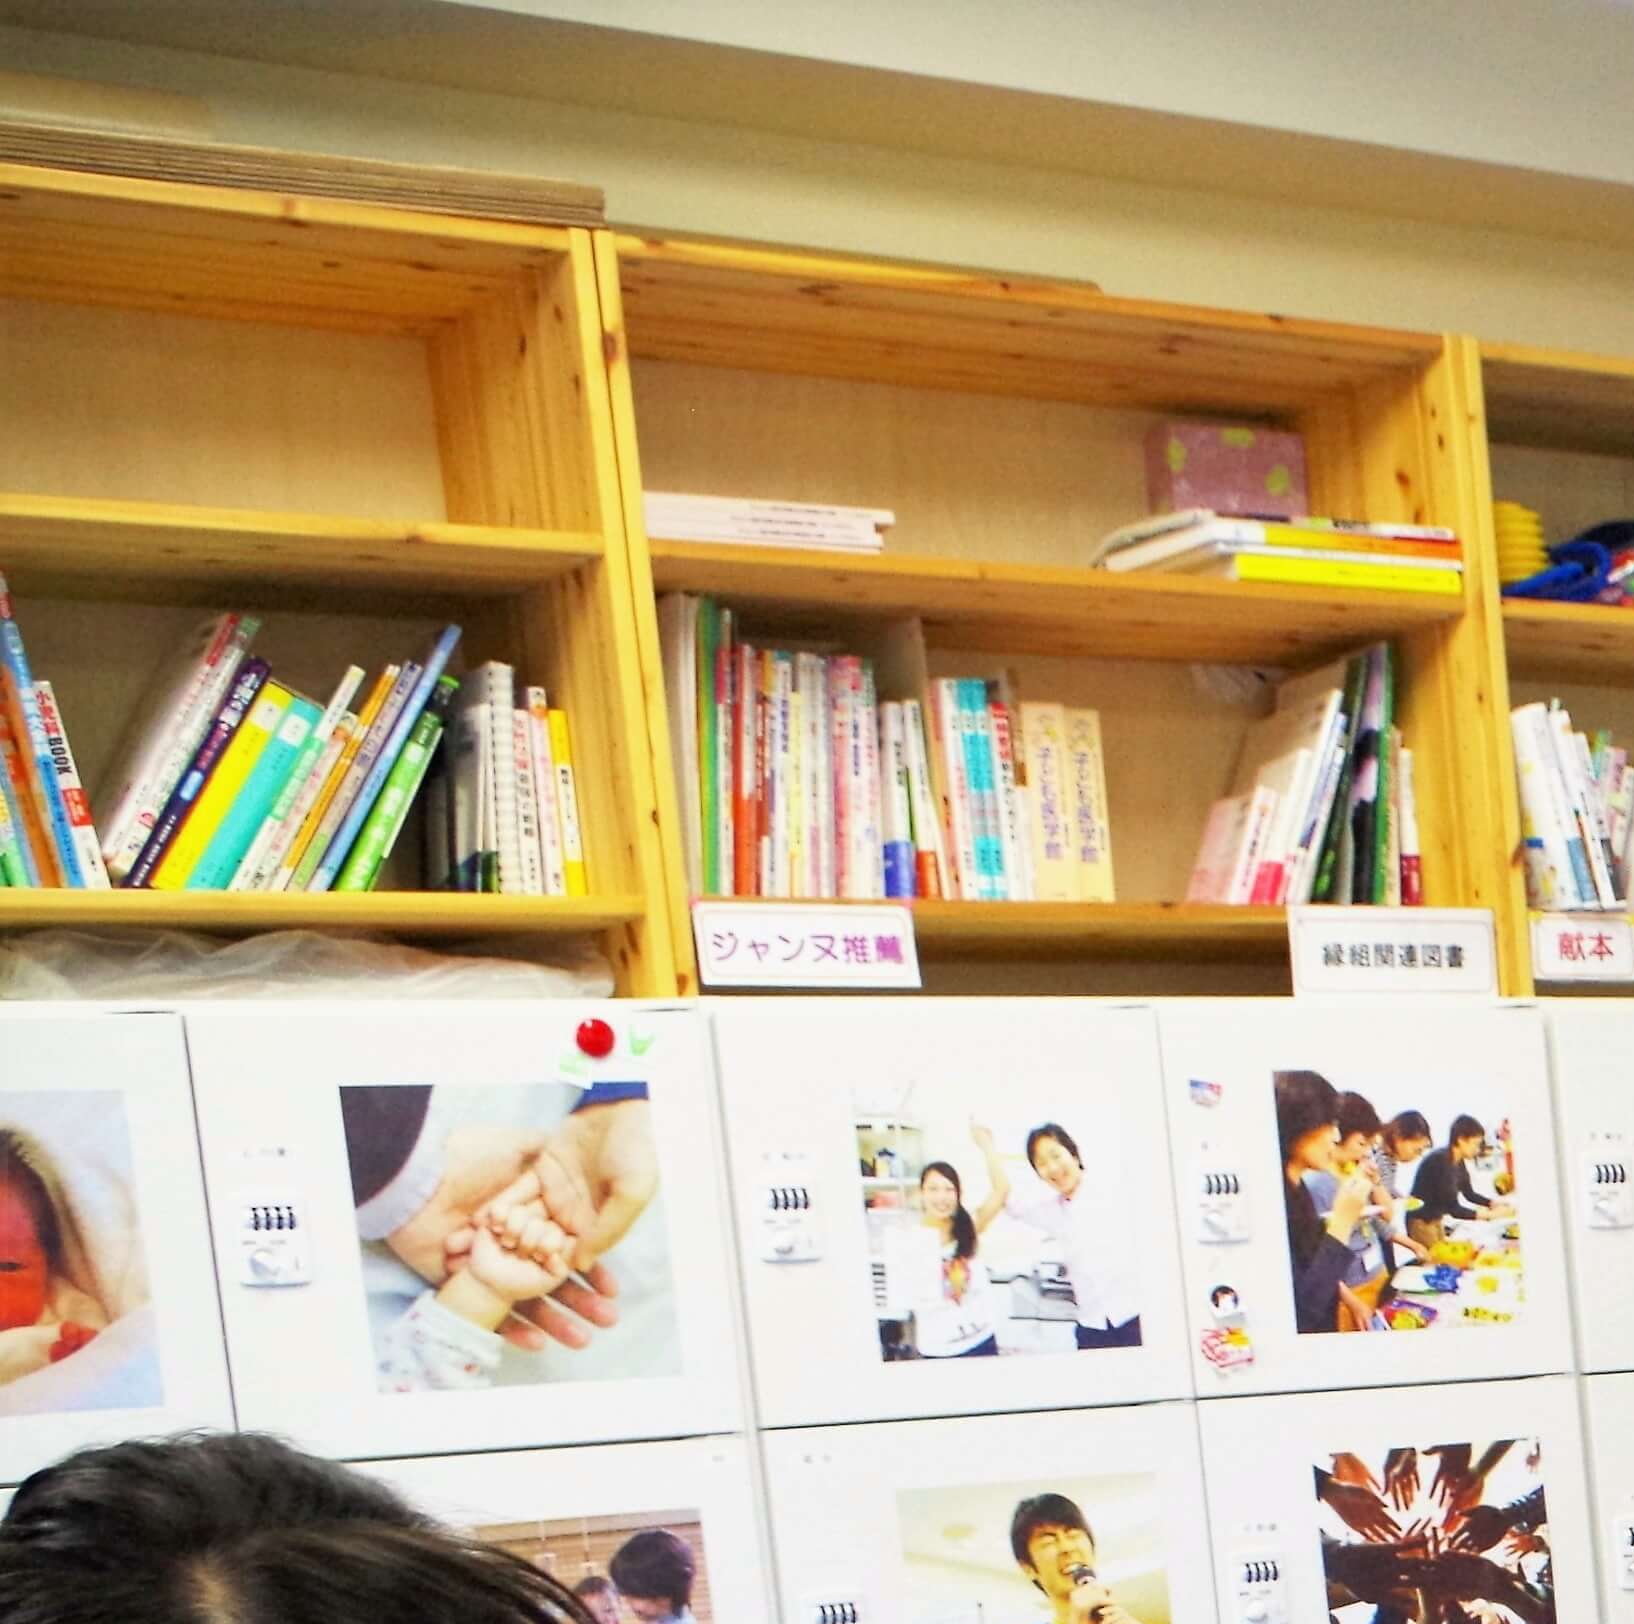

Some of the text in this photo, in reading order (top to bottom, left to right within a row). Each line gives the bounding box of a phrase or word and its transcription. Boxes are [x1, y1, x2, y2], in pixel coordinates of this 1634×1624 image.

[712, 931, 904, 964] ジャンヌ推薦
